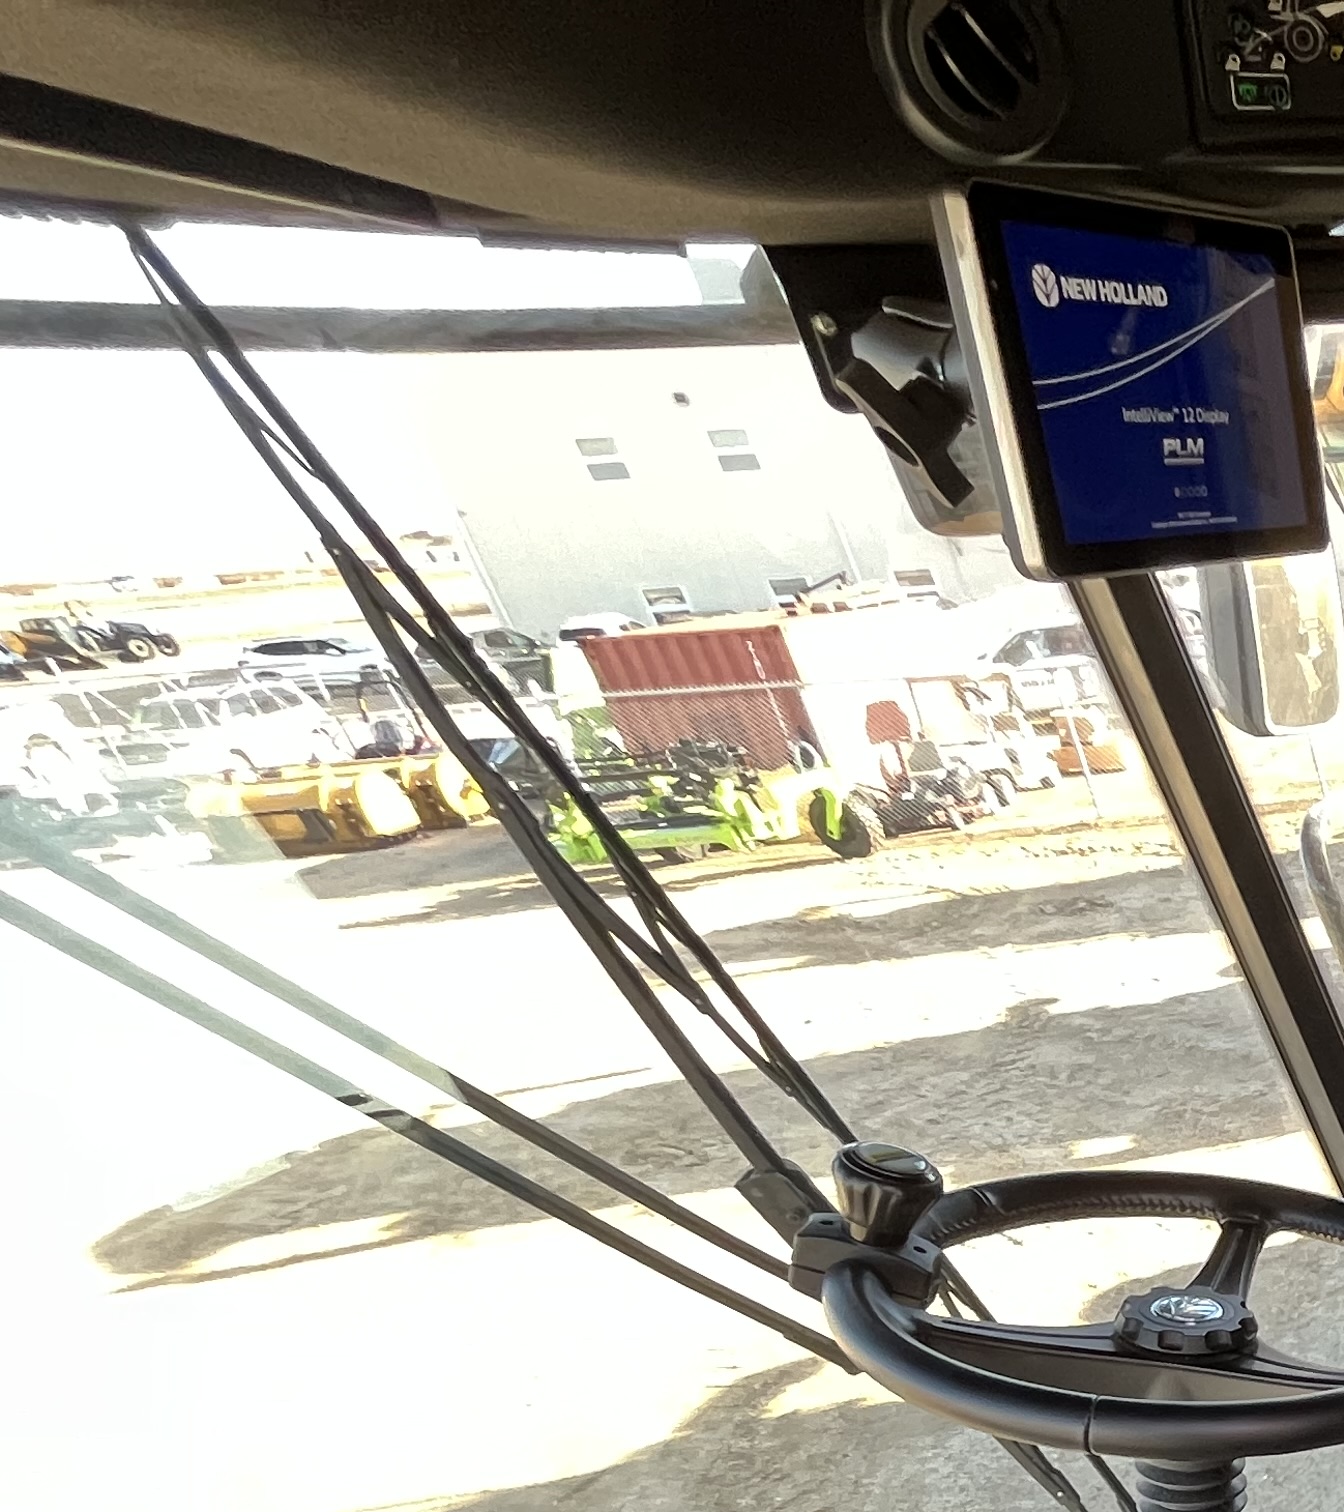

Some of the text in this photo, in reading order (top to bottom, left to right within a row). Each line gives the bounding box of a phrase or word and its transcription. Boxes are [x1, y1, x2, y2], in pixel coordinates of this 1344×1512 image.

[1059, 275, 1168, 307] NEW HOLLAND
[1182, 407, 1195, 423] 12
[1196, 407, 1230, 426] Display
[1163, 438, 1204, 456] PLM
